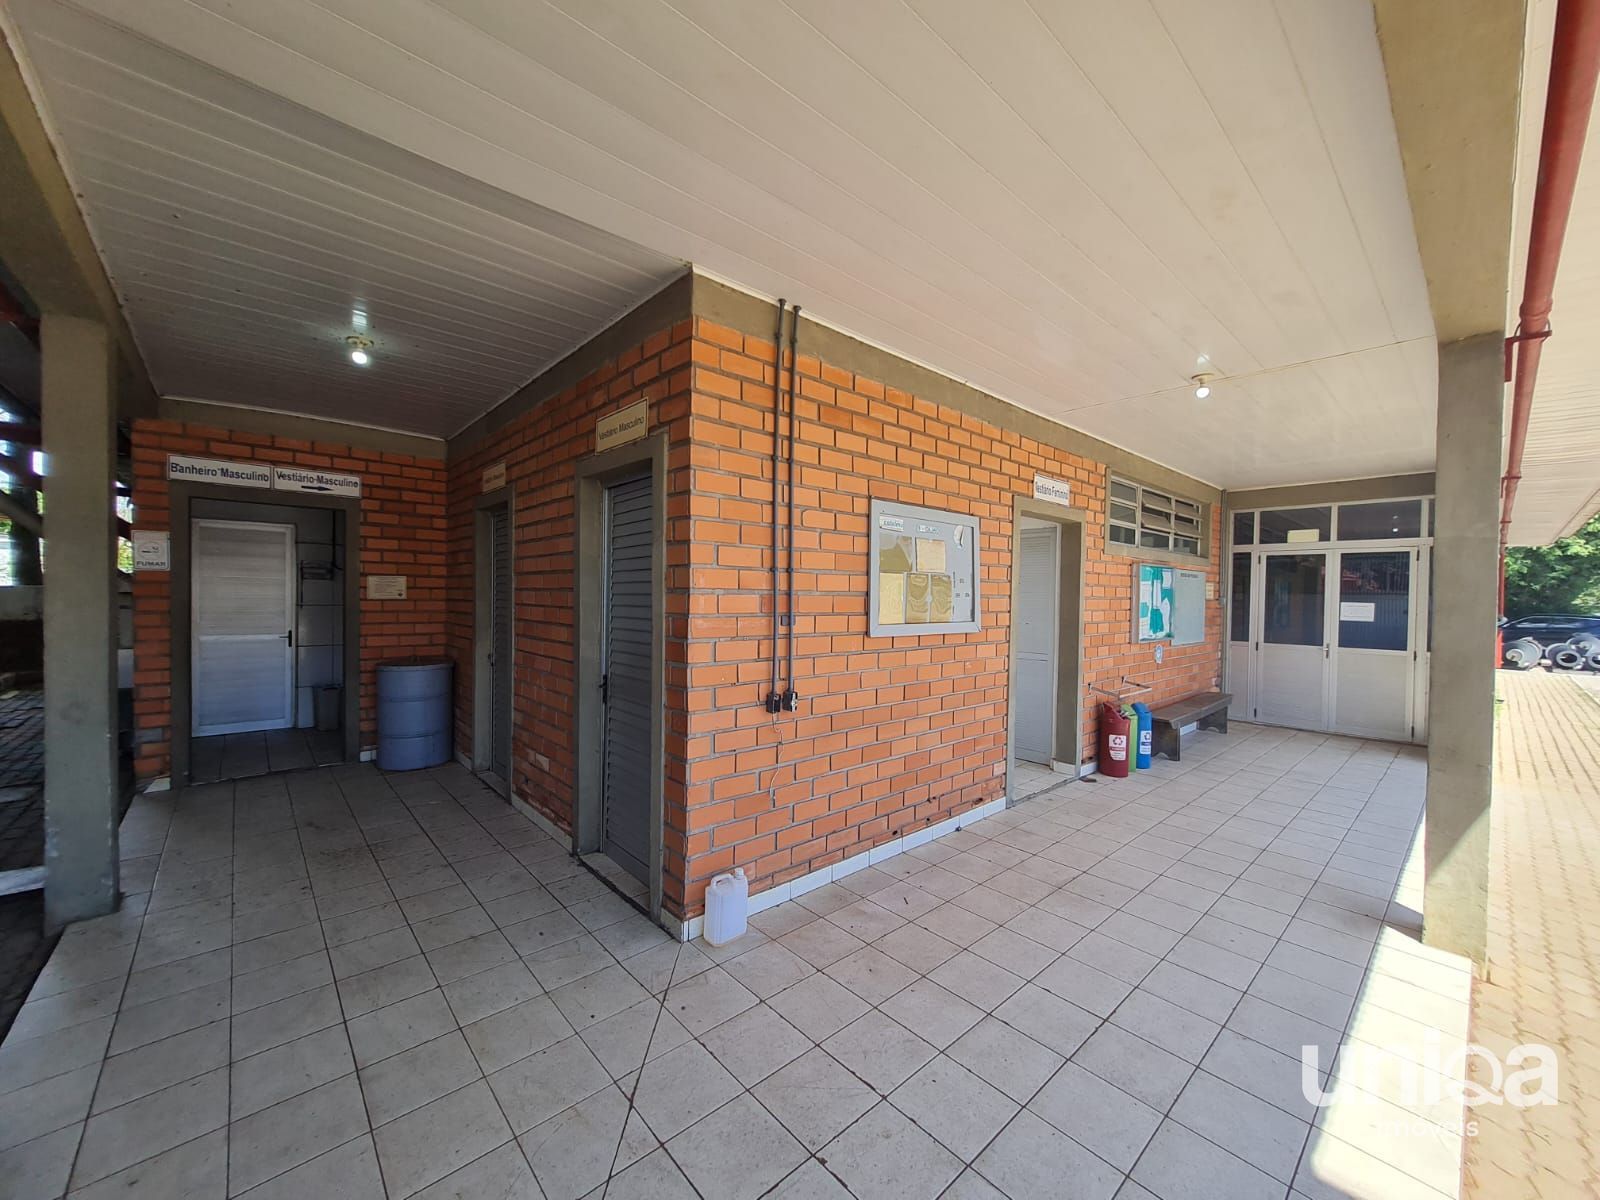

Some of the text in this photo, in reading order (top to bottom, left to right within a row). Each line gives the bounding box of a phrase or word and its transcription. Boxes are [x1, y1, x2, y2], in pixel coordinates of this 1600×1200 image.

[170, 462, 270, 482] Banheiro Masculino
[275, 470, 359, 489] Vestiário Masculino
[136, 560, 166, 568] FUMAR
